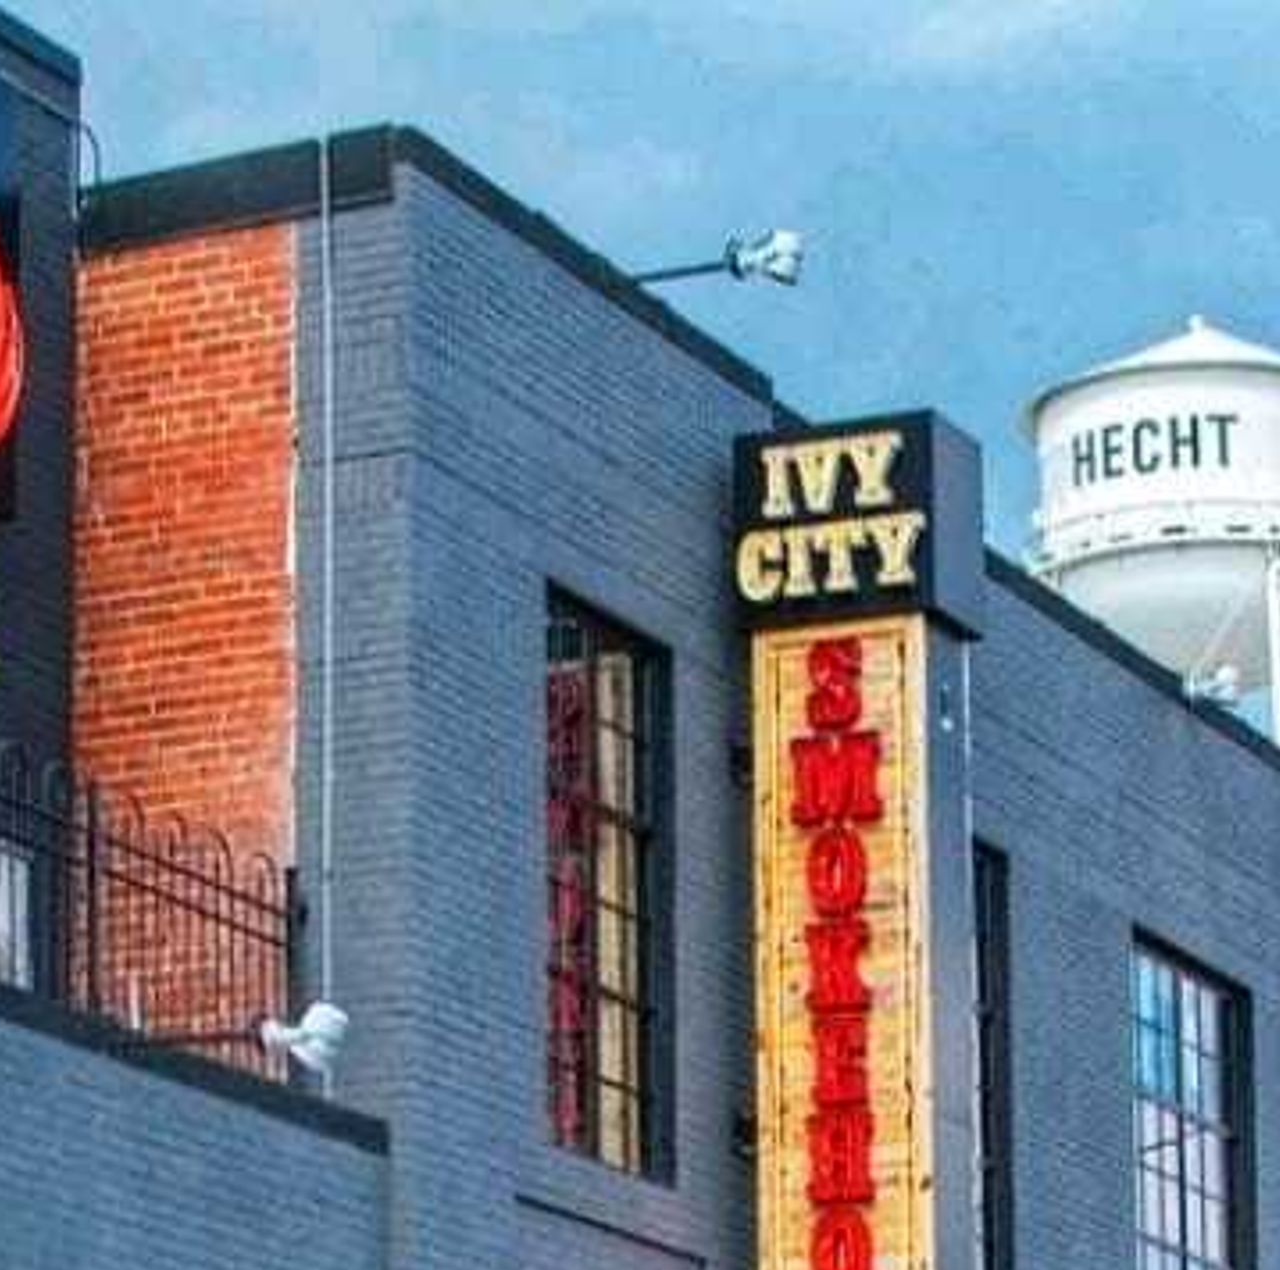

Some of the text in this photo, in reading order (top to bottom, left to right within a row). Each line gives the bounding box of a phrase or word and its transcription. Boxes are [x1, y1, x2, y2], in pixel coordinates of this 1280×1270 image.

[761, 431, 902, 518] IVY
[1071, 413, 1239, 488] HECHT
[736, 512, 925, 602] CITY
